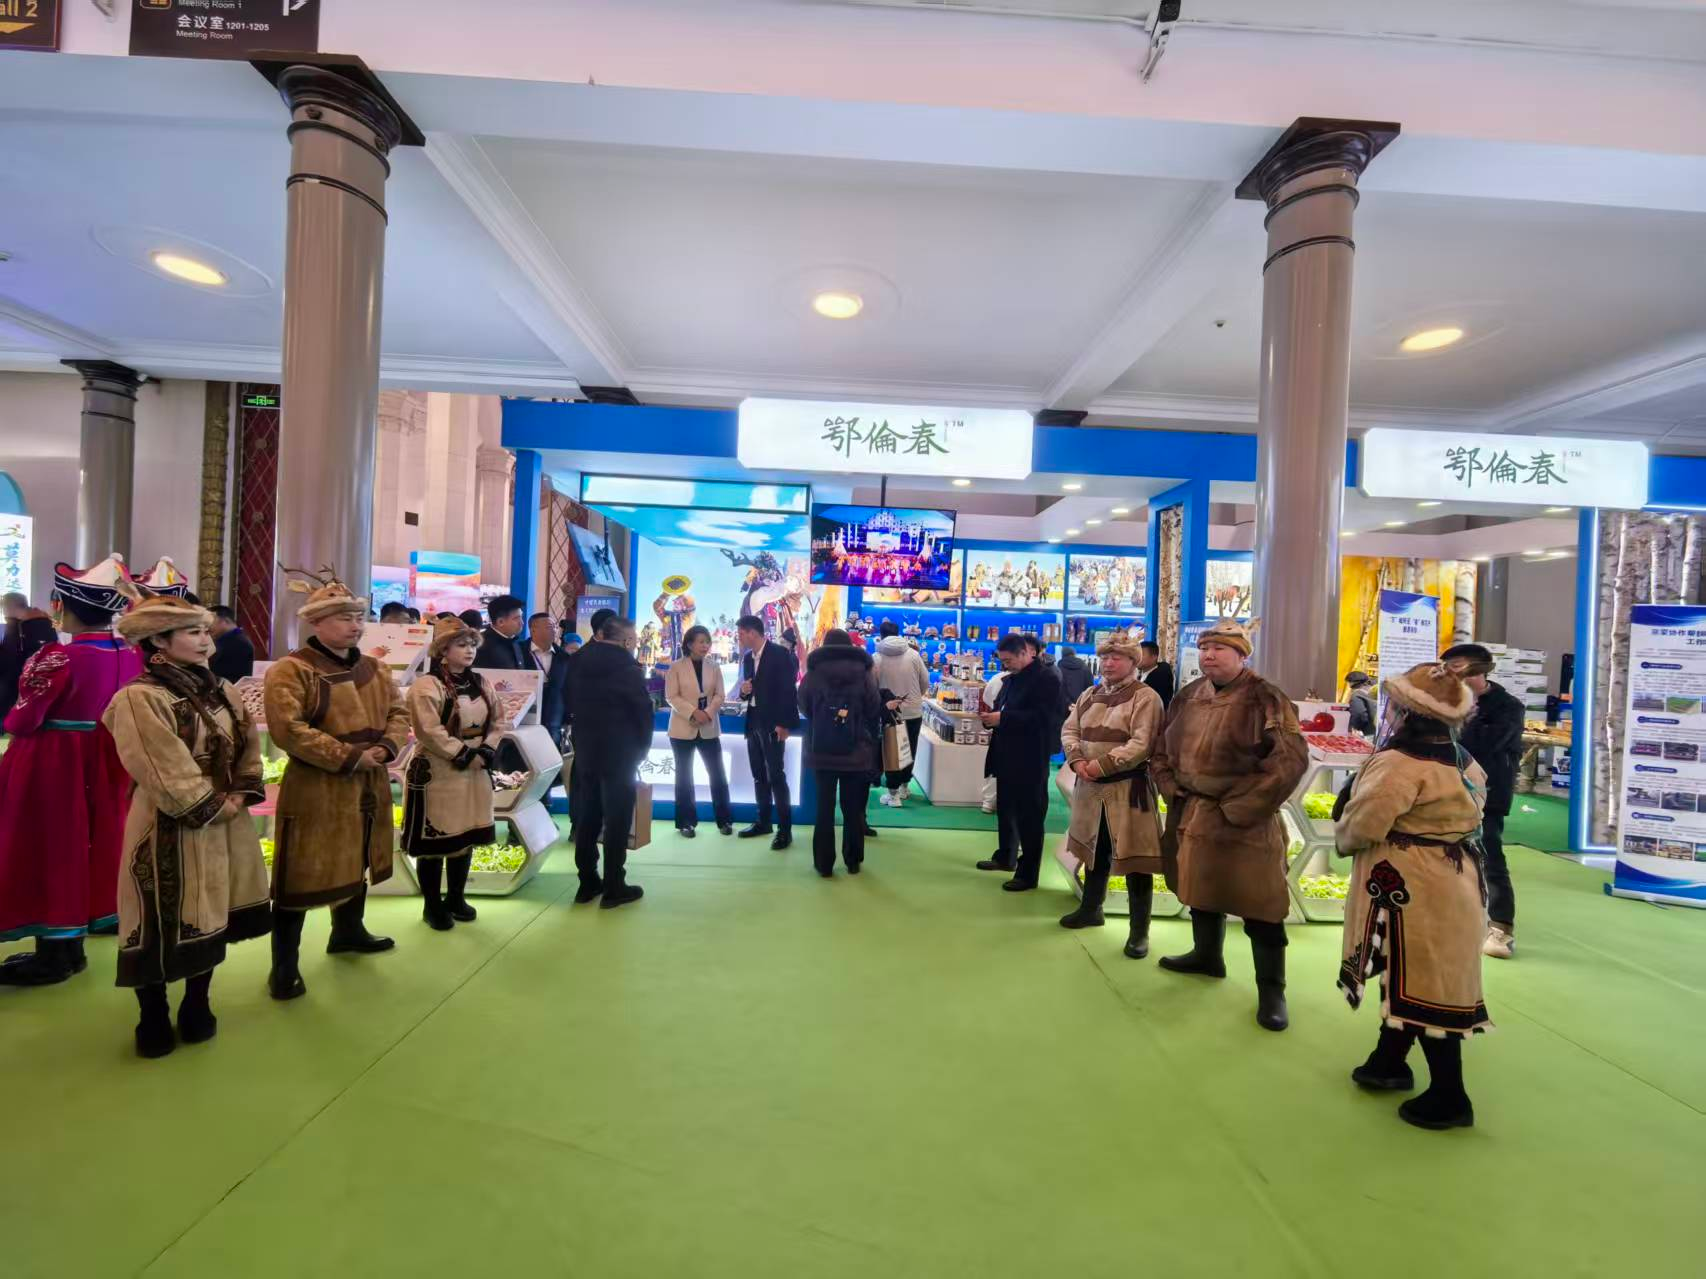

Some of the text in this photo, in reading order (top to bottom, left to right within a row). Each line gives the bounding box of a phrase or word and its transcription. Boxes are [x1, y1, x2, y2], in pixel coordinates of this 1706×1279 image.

[25, 0, 38, 17] 2
[212, 0, 235, 9] Room
[177, 14, 270, 31] 会议室 1201-1205
[176, 30, 233, 40] Meeting Room
[820, 416, 950, 458] 鄂倫春
[1443, 446, 1568, 488] 鄂倫春
